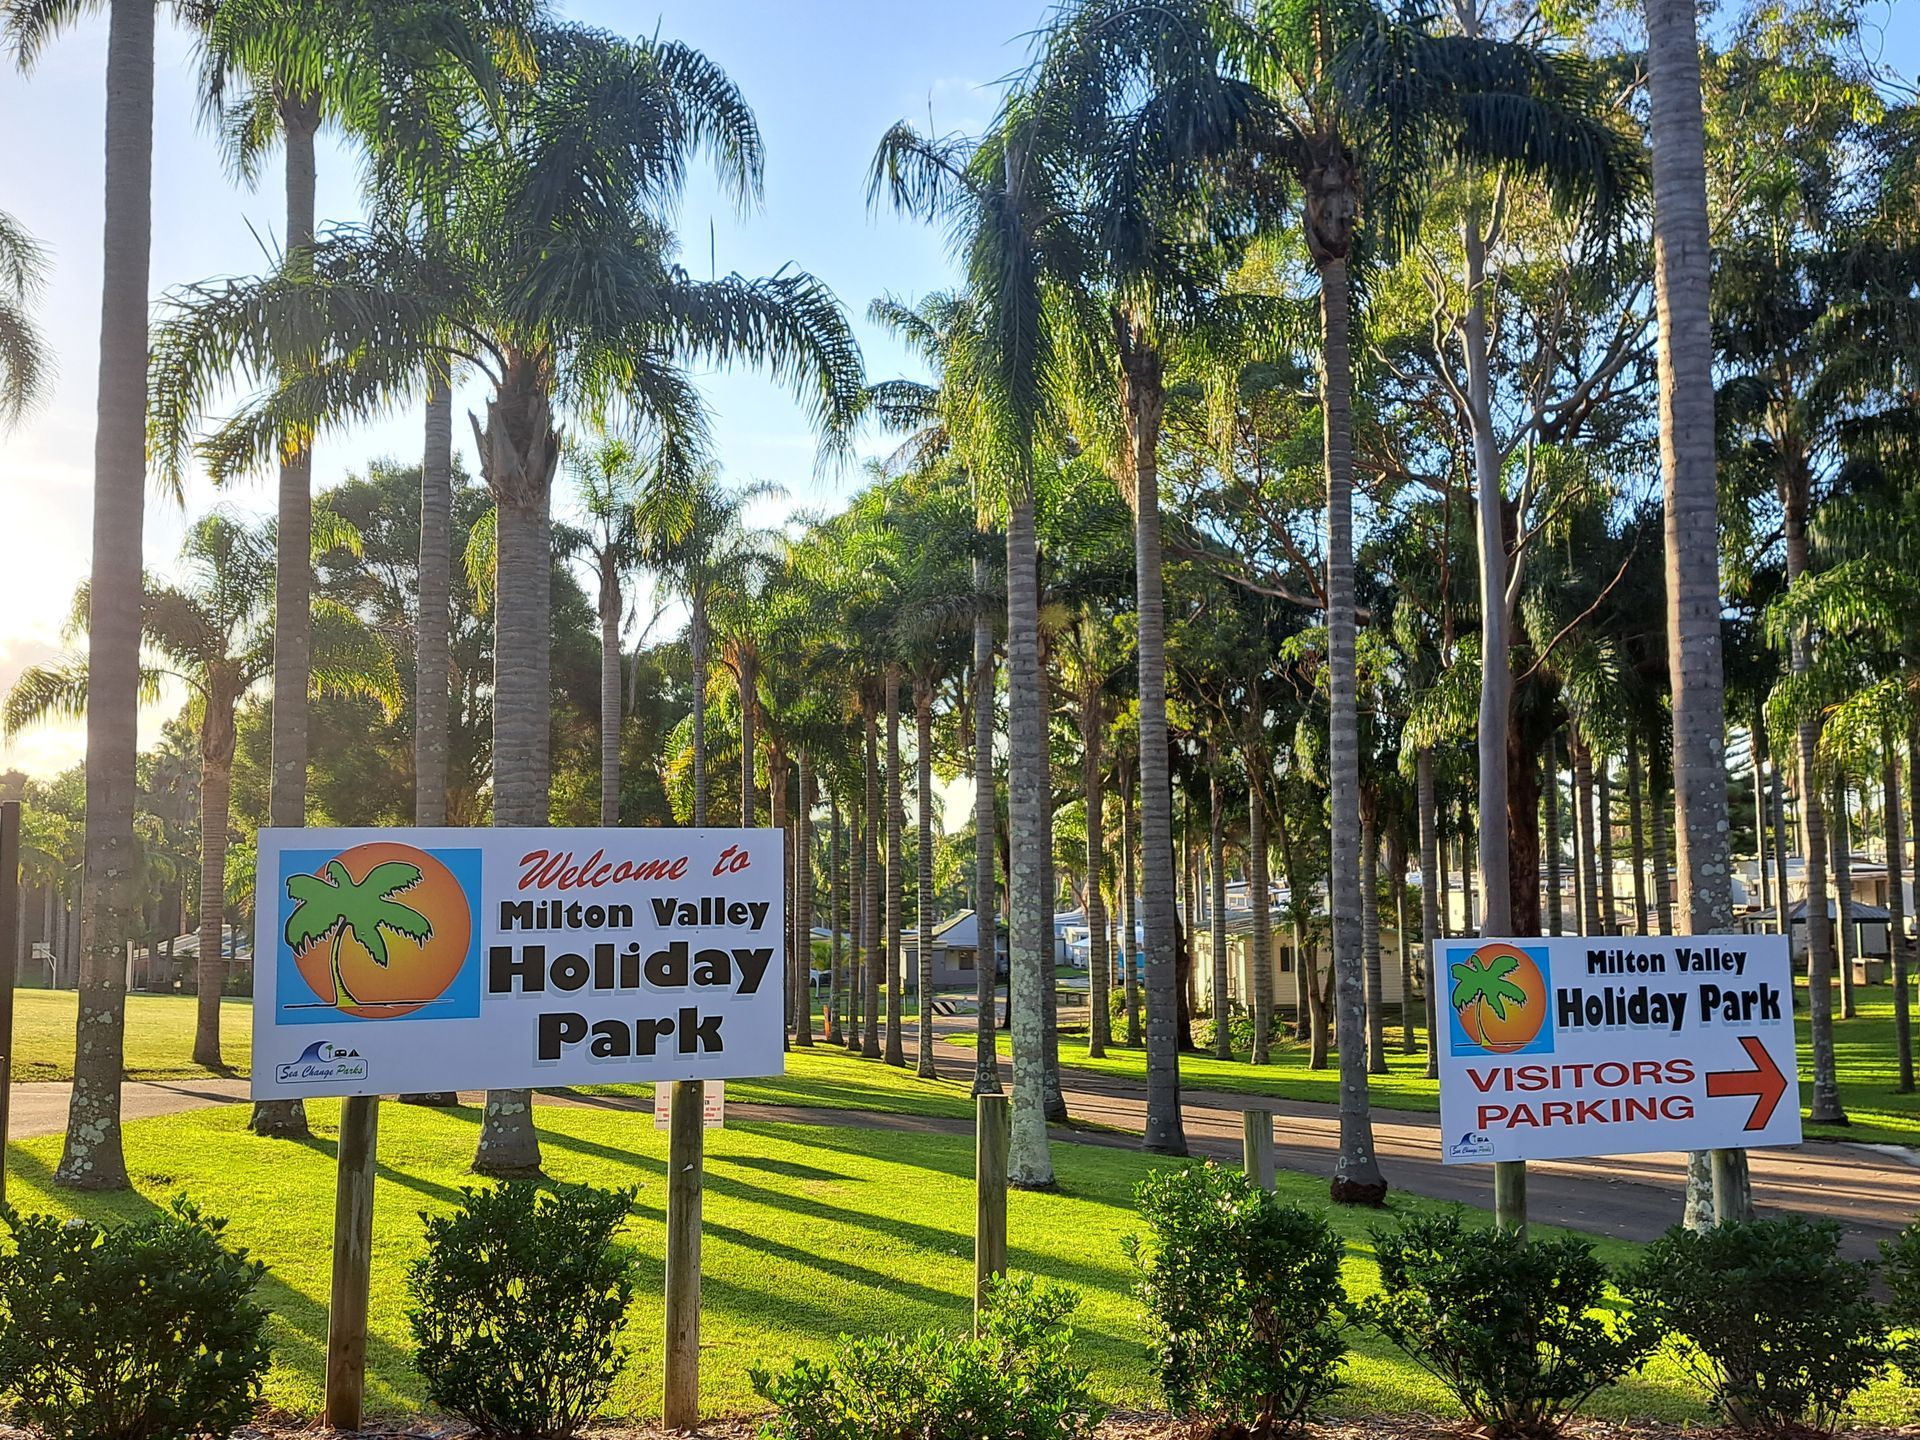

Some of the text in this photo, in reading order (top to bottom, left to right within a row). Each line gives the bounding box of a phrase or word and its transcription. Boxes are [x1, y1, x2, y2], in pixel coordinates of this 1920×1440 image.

[517, 844, 751, 891] Welcome to
[499, 896, 770, 931] Milton Valley
[488, 941, 775, 995] Holiday
[1586, 948, 1748, 976] Milton Valley
[1556, 982, 1782, 1032] Holiday Park
[537, 1006, 724, 1061] Park
[280, 1063, 364, 1080] Sea Change Parks
[1465, 1059, 1697, 1093] VISITORS
[1476, 1095, 1695, 1130] PARKING
